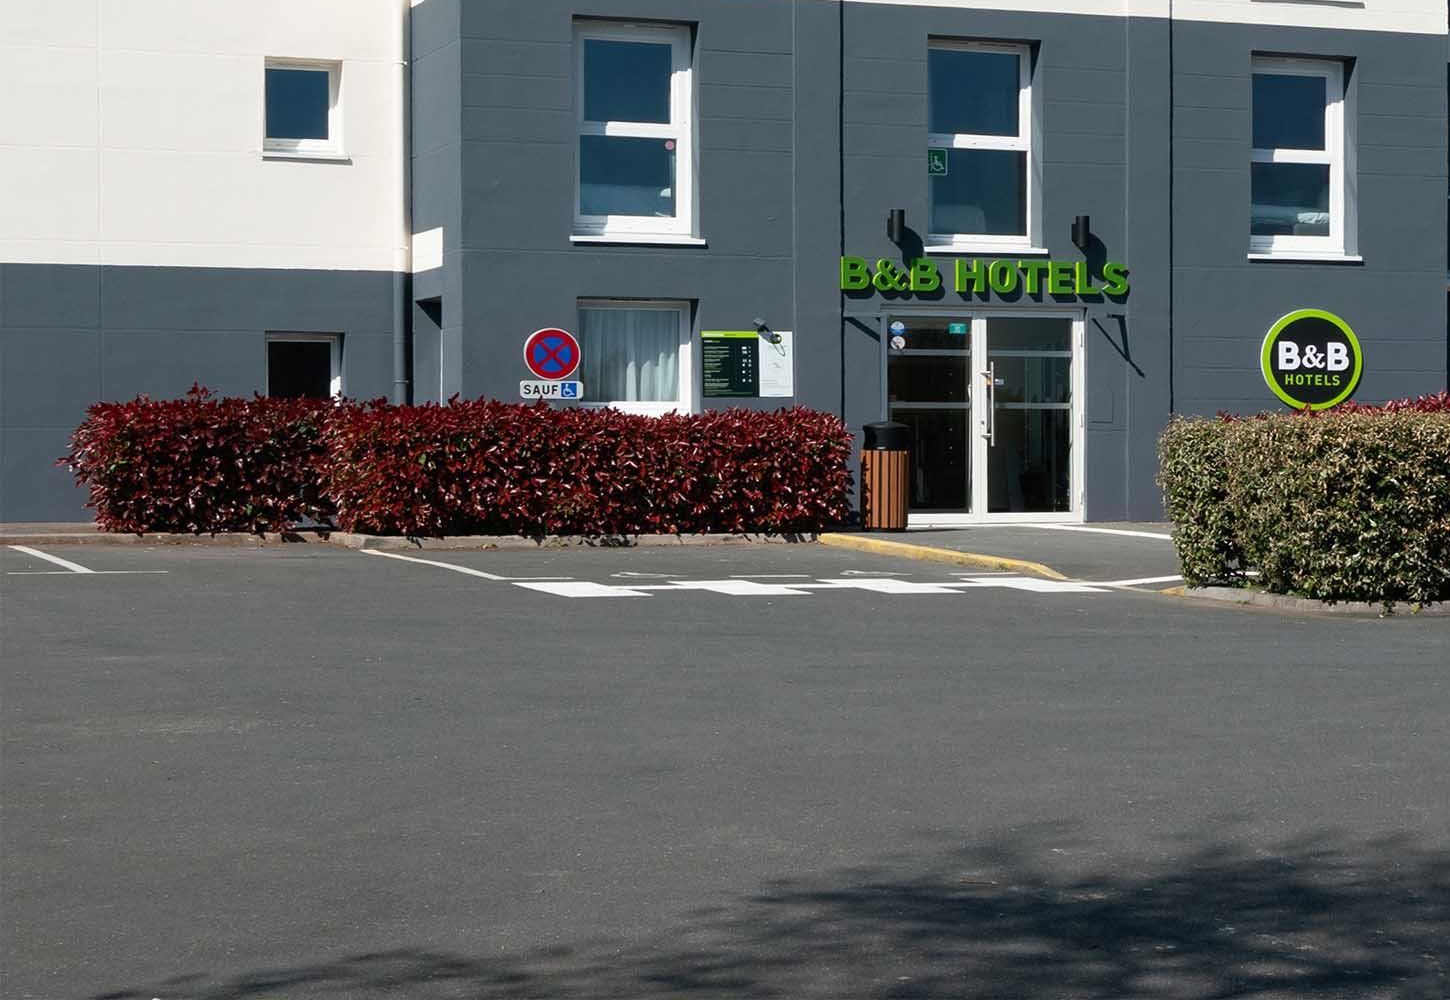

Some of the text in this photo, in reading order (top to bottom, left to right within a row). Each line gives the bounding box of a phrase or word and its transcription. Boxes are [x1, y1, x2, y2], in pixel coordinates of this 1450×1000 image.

[840, 256, 1130, 295] B&B HOTELS
[1278, 341, 1350, 371] B&B
[523, 384, 559, 395] SAUF
[1284, 374, 1341, 386] HOTELS
